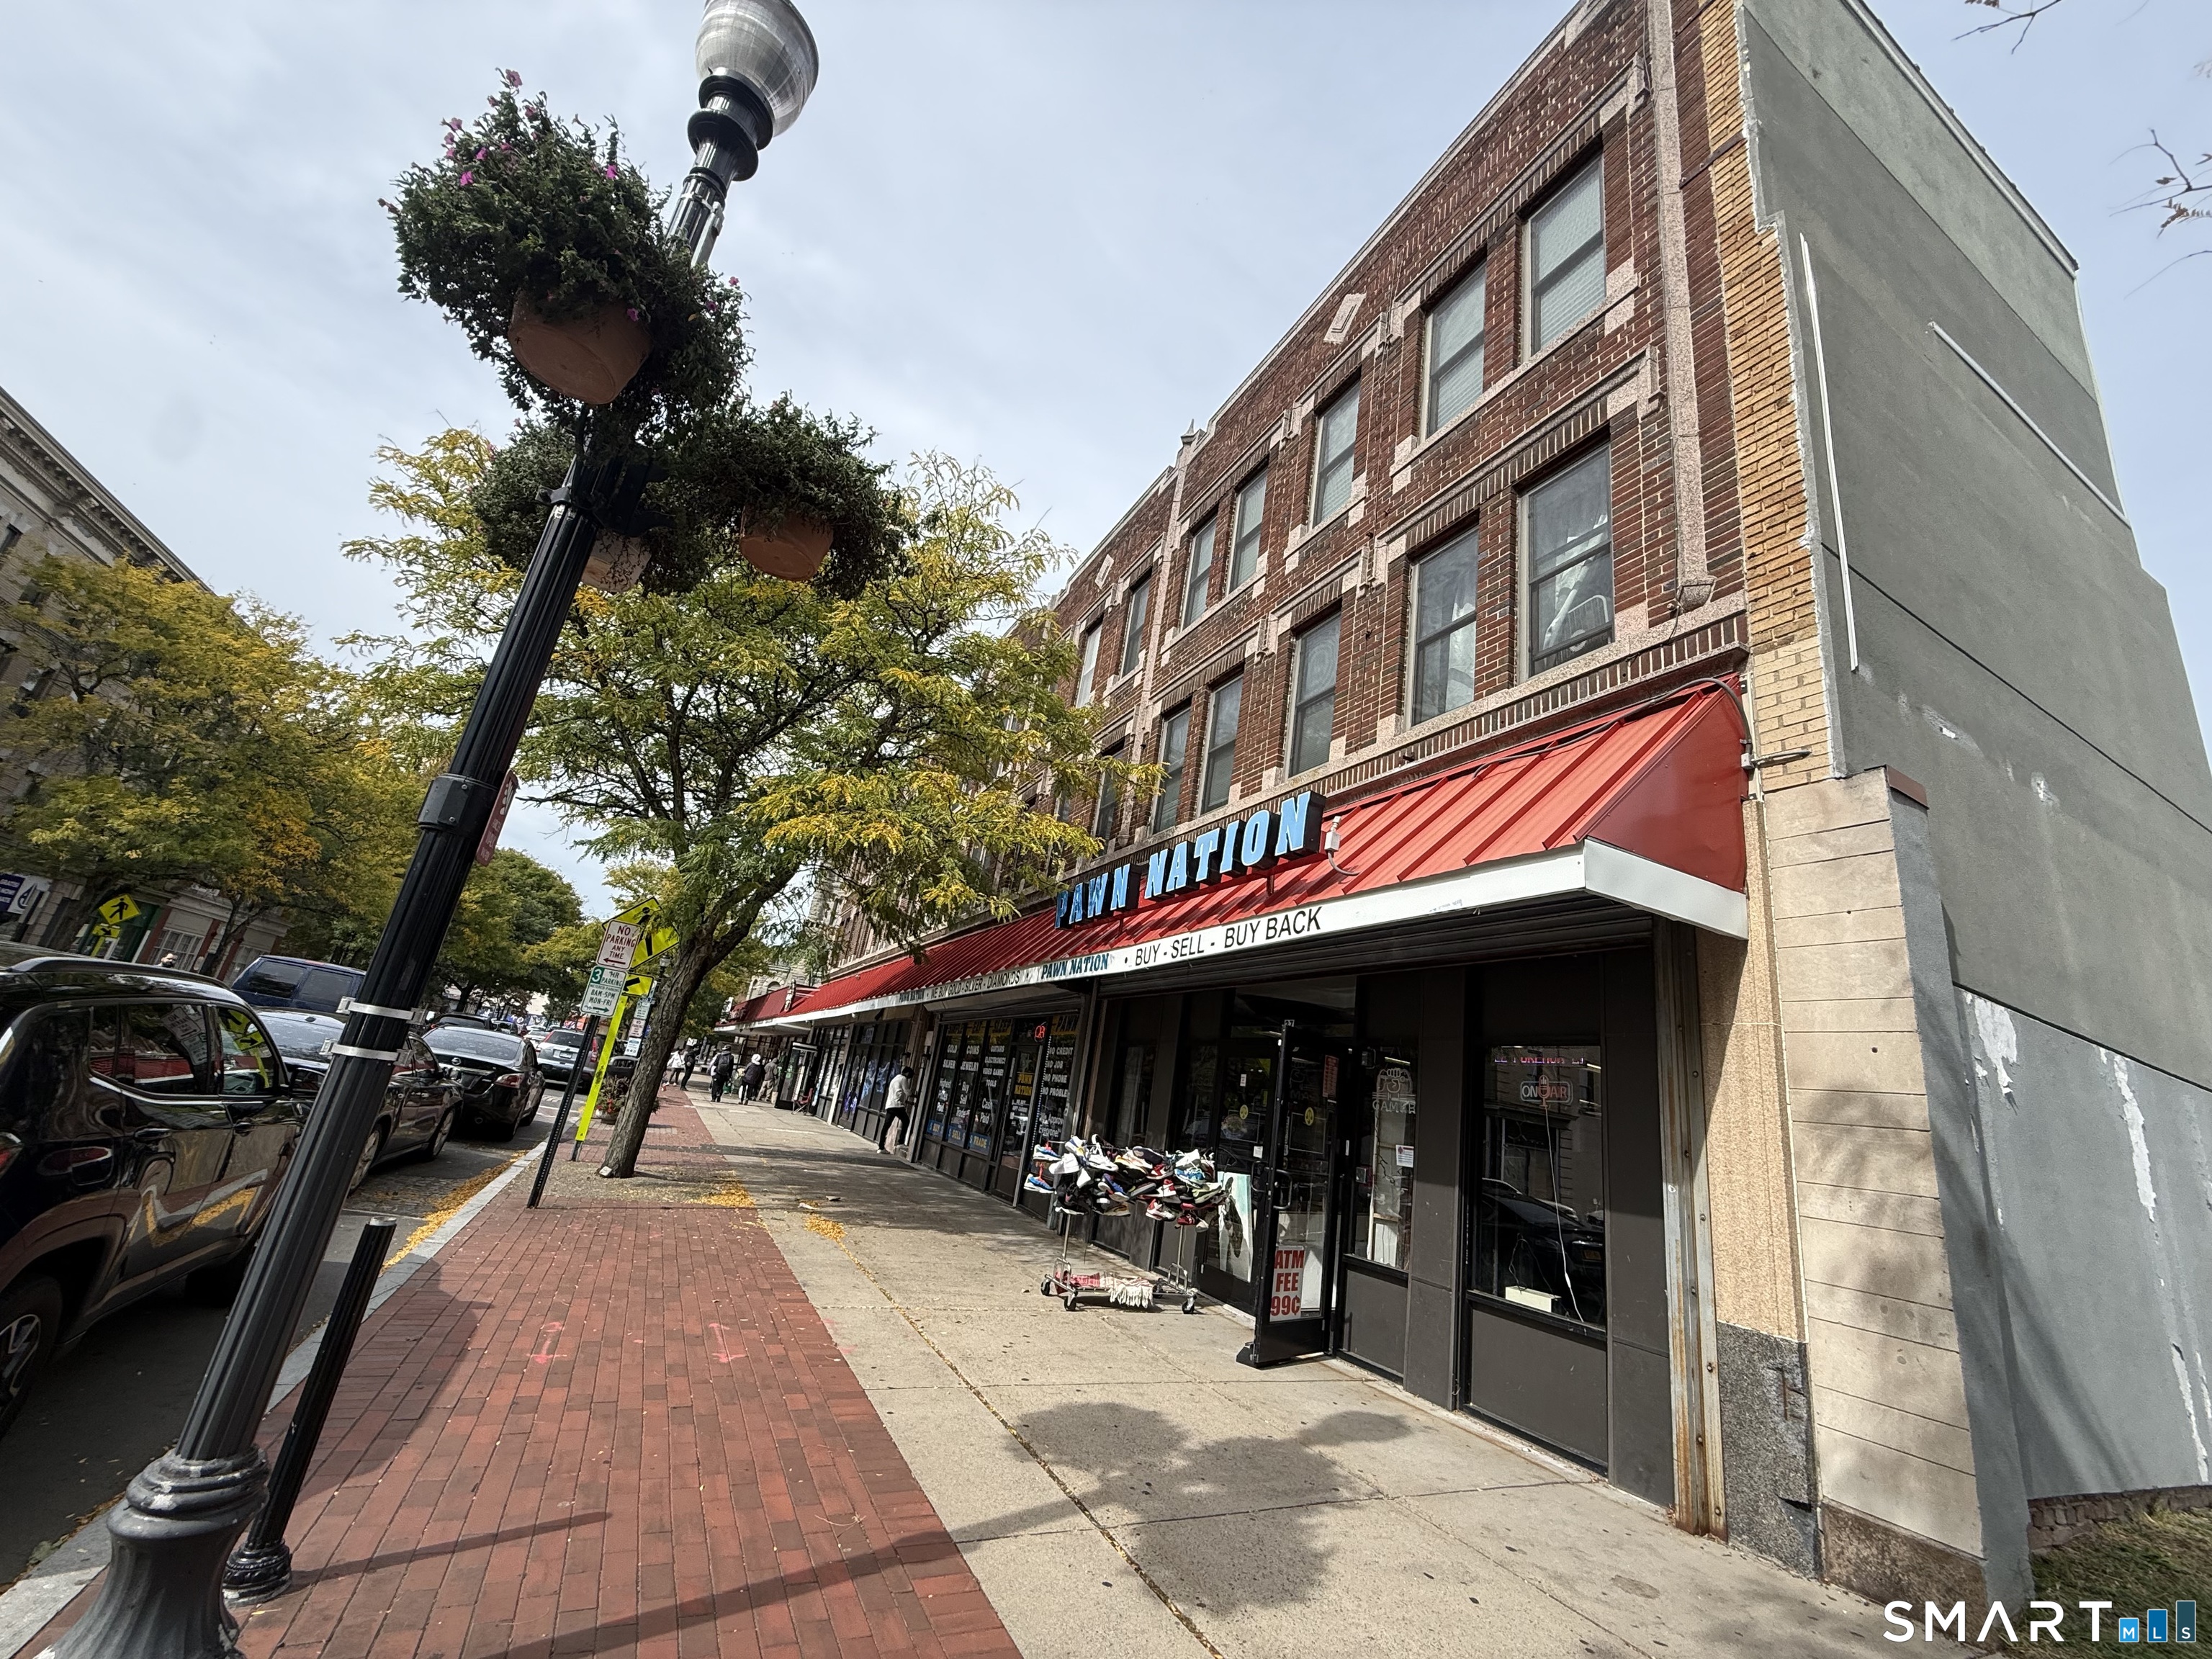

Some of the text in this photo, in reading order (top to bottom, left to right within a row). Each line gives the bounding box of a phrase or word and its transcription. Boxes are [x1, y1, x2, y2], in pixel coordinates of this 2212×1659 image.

[1055, 791, 1311, 929] PAWN NATION
[617, 925, 631, 935] NO
[606, 934, 637, 948] PARKING
[609, 951, 624, 960] TIME
[938, 986, 948, 998] BUY
[948, 982, 962, 996] GOLD
[964, 978, 983, 993] SILVER
[987, 970, 1020, 989] DIAMONDS
[1041, 961, 1068, 979] PAWN
[1069, 953, 1109, 975] NATION
[1135, 943, 1161, 966] BUY
[1171, 935, 1204, 958] SELL
[1224, 920, 1261, 948] BUY
[1266, 906, 1323, 940] BACK
[591, 968, 602, 982] 3
[601, 977, 623, 987] PARKING
[590, 989, 616, 999] 8AM-5PM
[589, 997, 613, 1007] MON-FRI
[966, 1045, 979, 1055] COINS
[1056, 1047, 1074, 1056] CREDIT
[960, 1061, 979, 1071] JEWELRY
[1051, 1074, 1068, 1083] PHONE
[961, 1081, 970, 1094] Buy
[1521, 1084, 1568, 1099] ON AIR
[1274, 1249, 1305, 1269] ATM
[1275, 1272, 1300, 1292] FEE
[1269, 1295, 1301, 1316] 99¢
